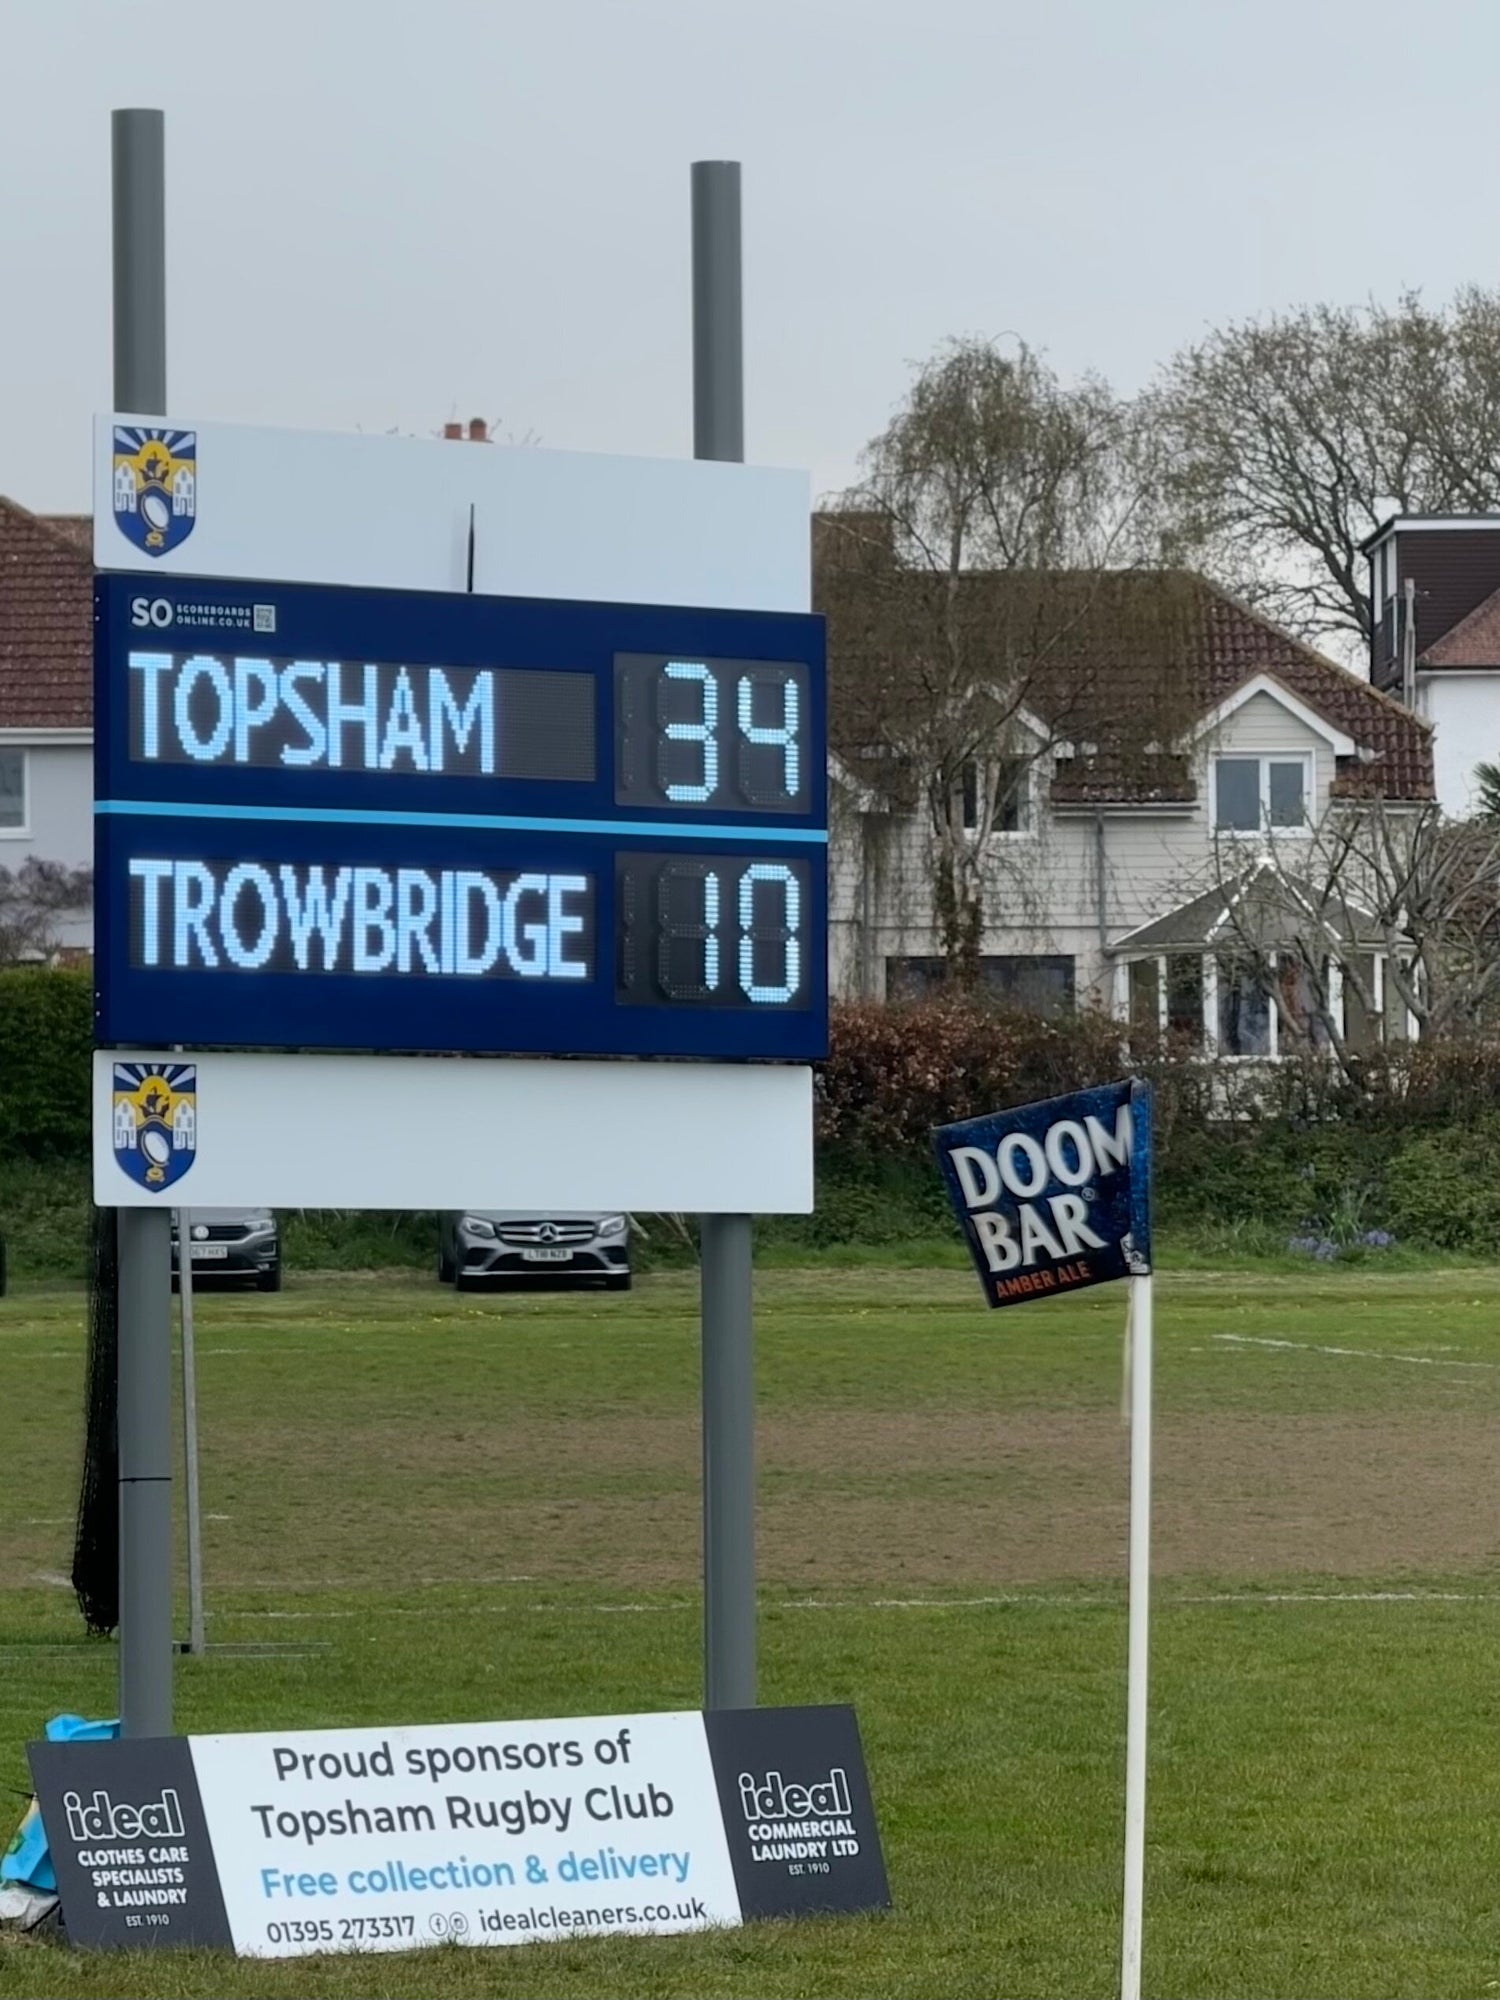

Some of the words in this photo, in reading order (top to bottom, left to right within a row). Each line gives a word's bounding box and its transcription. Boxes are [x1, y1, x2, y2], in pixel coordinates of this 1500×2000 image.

[131, 597, 173, 628] SO
[176, 604, 251, 616] SCOREBOARDS
[176, 615, 251, 628] ONLINE.CO.UK
[128, 651, 495, 774] TOPSHAM
[664, 661, 799, 802] 34
[128, 858, 587, 979] TROWBRIDGE
[704, 864, 800, 1003] 10
[948, 1103, 1134, 1209] DOOM
[995, 1269, 1057, 1299] AMBER
[1057, 1260, 1091, 1286] ALE
[273, 1742, 395, 1781] Proud
[407, 1739, 584, 1782] sponsors
[594, 1728, 632, 1764] of
[738, 1768, 852, 1820] ideal
[63, 1789, 186, 1841] ideal
[250, 1799, 436, 1845] Topsham
[447, 1790, 573, 1835] Rugby
[584, 1783, 674, 1823] Club
[748, 1819, 856, 1841] COMMERCIAL
[78, 1848, 146, 1867] CLOTHES
[148, 1846, 190, 1864] CARE
[751, 1841, 827, 1861] LAUNDRY
[832, 1839, 860, 1856] LTD
[92, 1867, 185, 1887] SPECIALISTS
[260, 1867, 339, 1898] Free
[349, 1854, 514, 1893] collection
[525, 1854, 548, 1884] &
[558, 1847, 691, 1883] delivery
[807, 1862, 830, 1874] 1910
[97, 1891, 112, 1908] &
[113, 1887, 188, 1907] LAUNDRY
[145, 1914, 170, 1926] 1910
[266, 1918, 334, 1943] 01395
[338, 1914, 415, 1940] 273317
[479, 1897, 708, 1932] idealcleaners.co.uk
